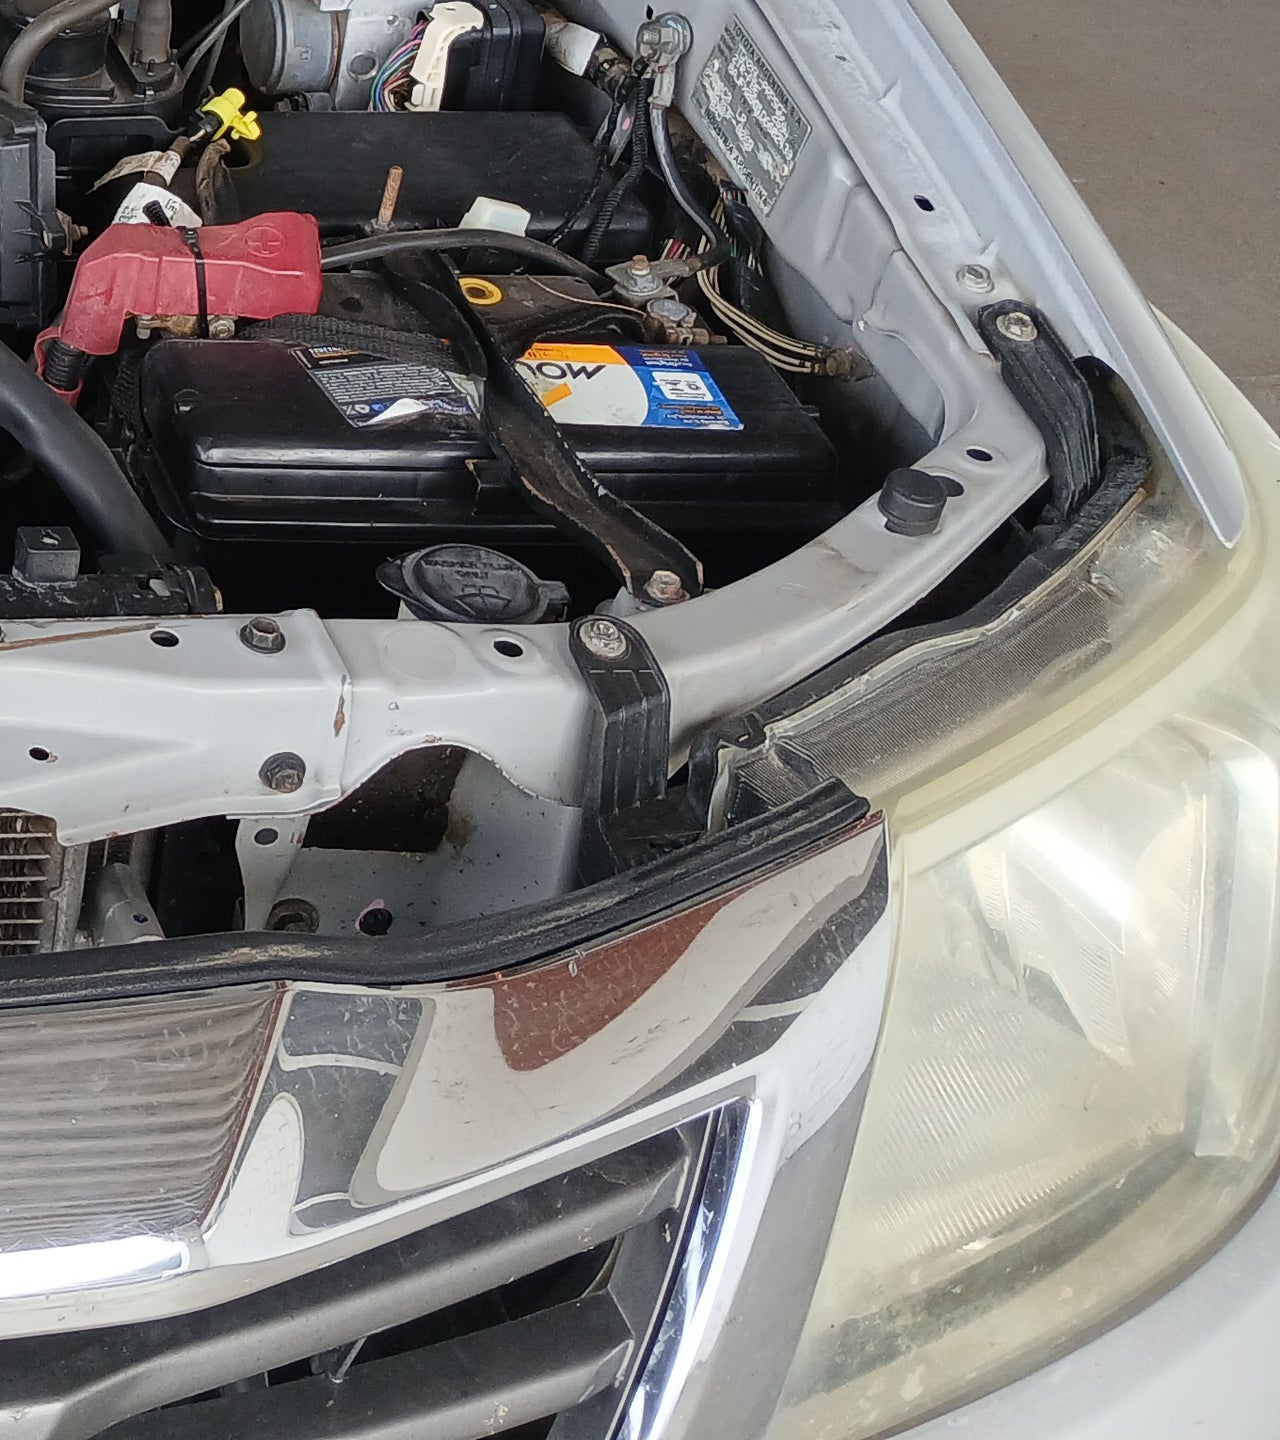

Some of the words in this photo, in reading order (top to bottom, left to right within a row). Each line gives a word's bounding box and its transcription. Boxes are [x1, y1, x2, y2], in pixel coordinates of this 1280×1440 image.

[732, 22, 756, 57] TOYOTA
[753, 56, 790, 107] ARGENTINA
[702, 108, 734, 157] INDUSTRIA
[732, 154, 771, 211] ARGENTINA
